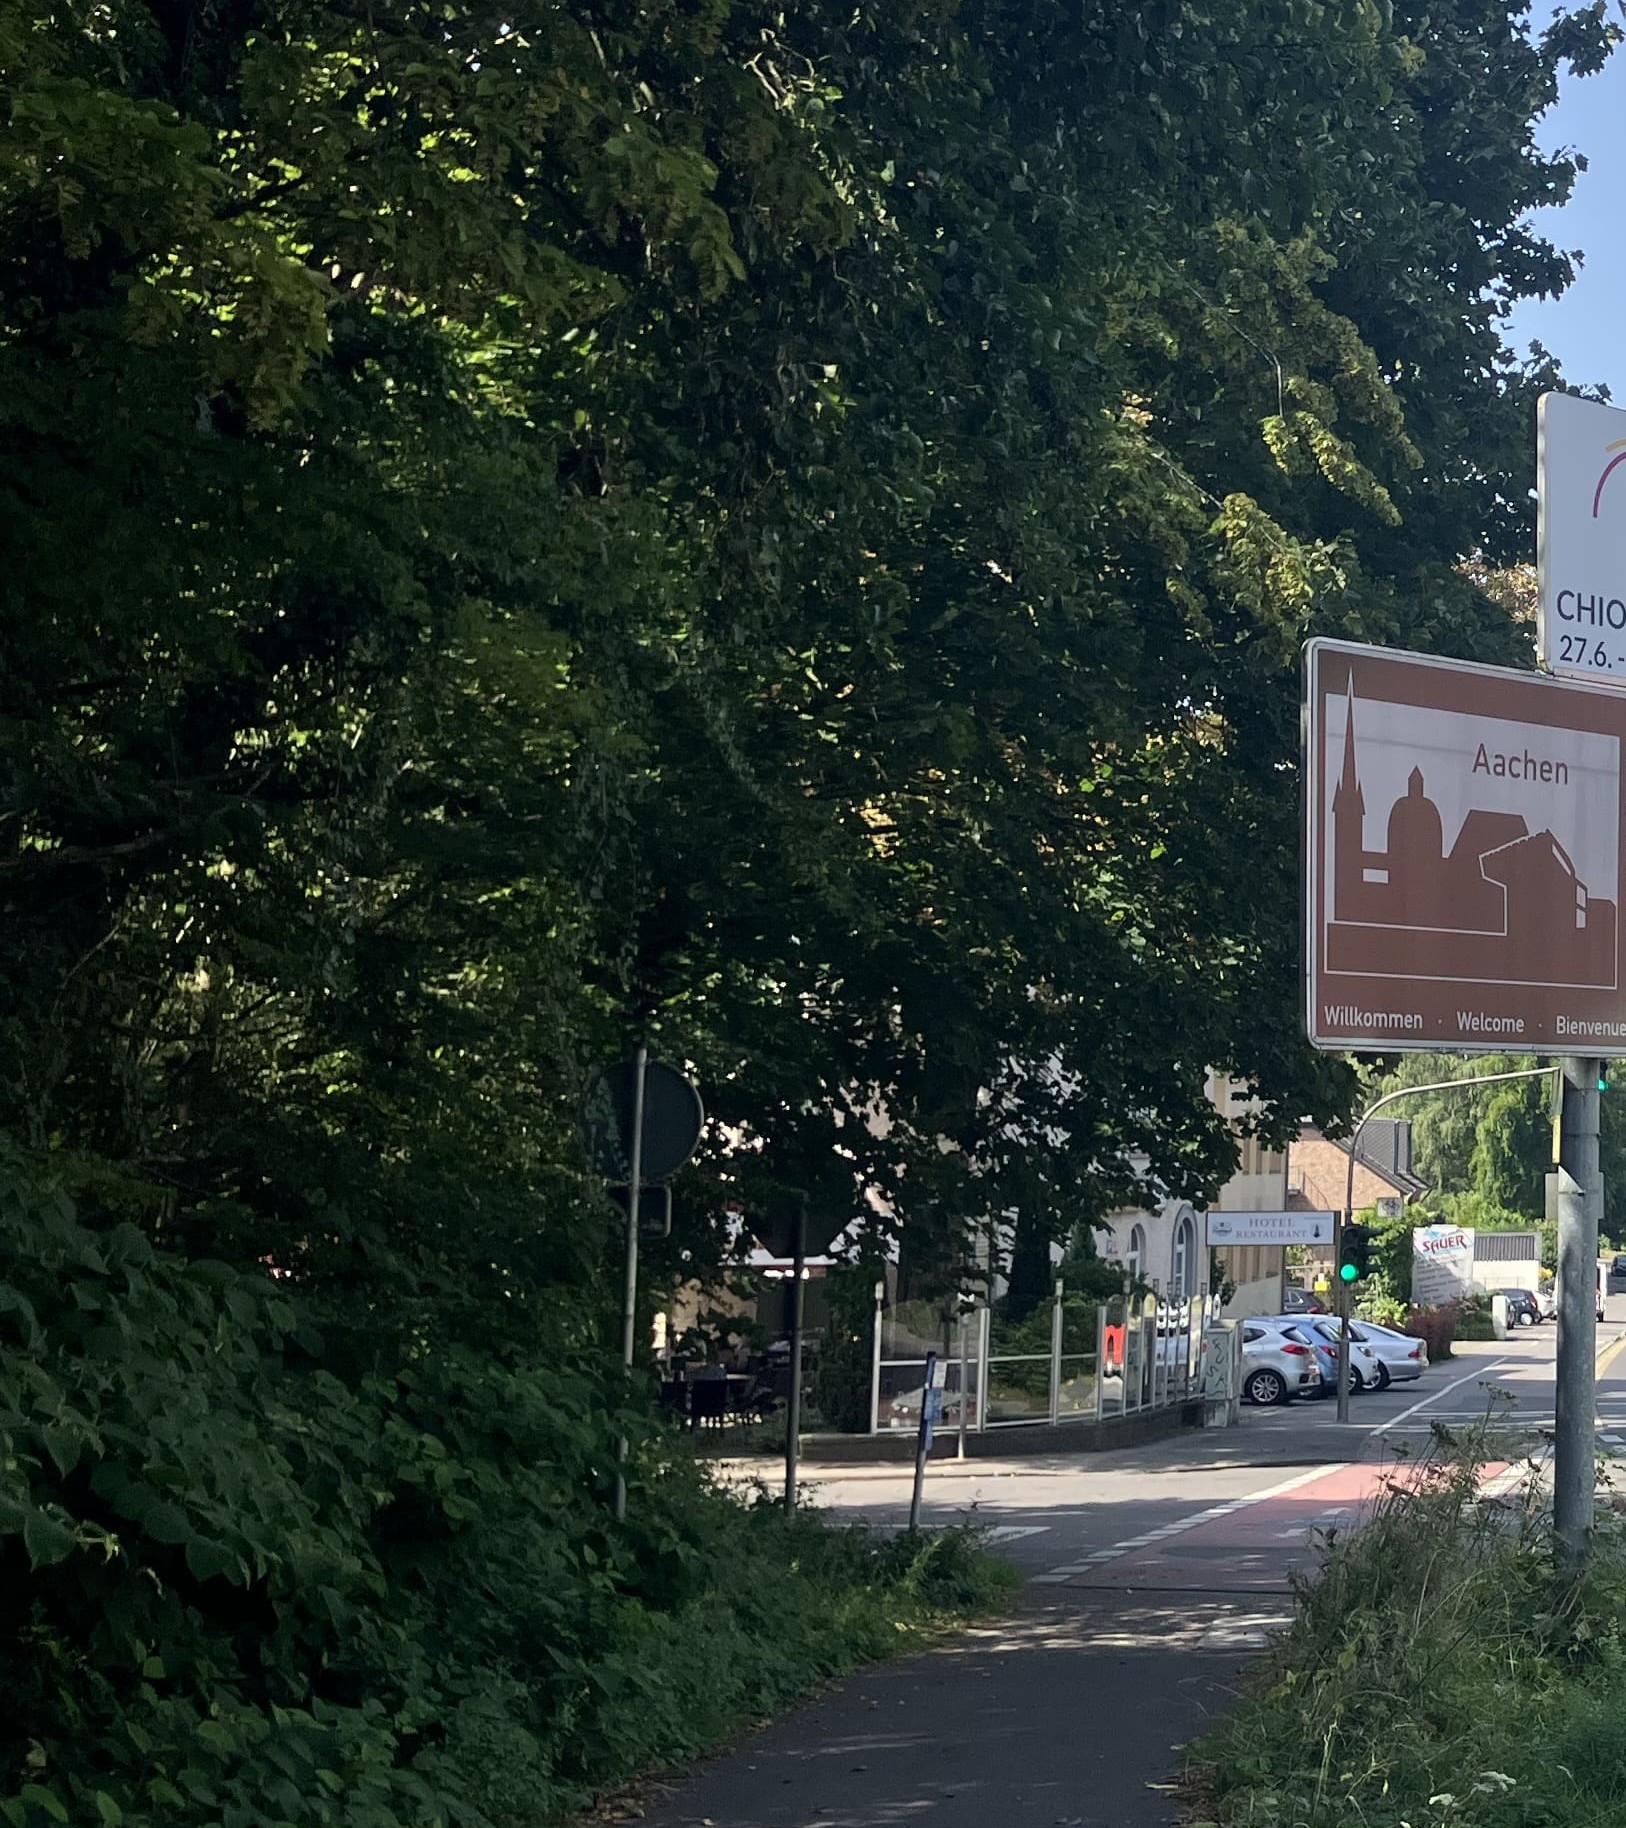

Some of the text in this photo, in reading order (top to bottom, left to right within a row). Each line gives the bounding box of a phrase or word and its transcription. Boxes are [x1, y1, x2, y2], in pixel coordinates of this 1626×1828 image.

[1557, 590, 1626, 630] CHIO
[1560, 634, 1612, 669] 27.6.
[1472, 743, 1568, 785] Aachen
[1324, 1005, 1423, 1029] Willkommen
[1457, 1011, 1524, 1034] Welcome
[1236, 1229, 1306, 1239] RESTAURANT
[1249, 1218, 1295, 1228] HOTEL
[1423, 1235, 1467, 1254] SAUER
